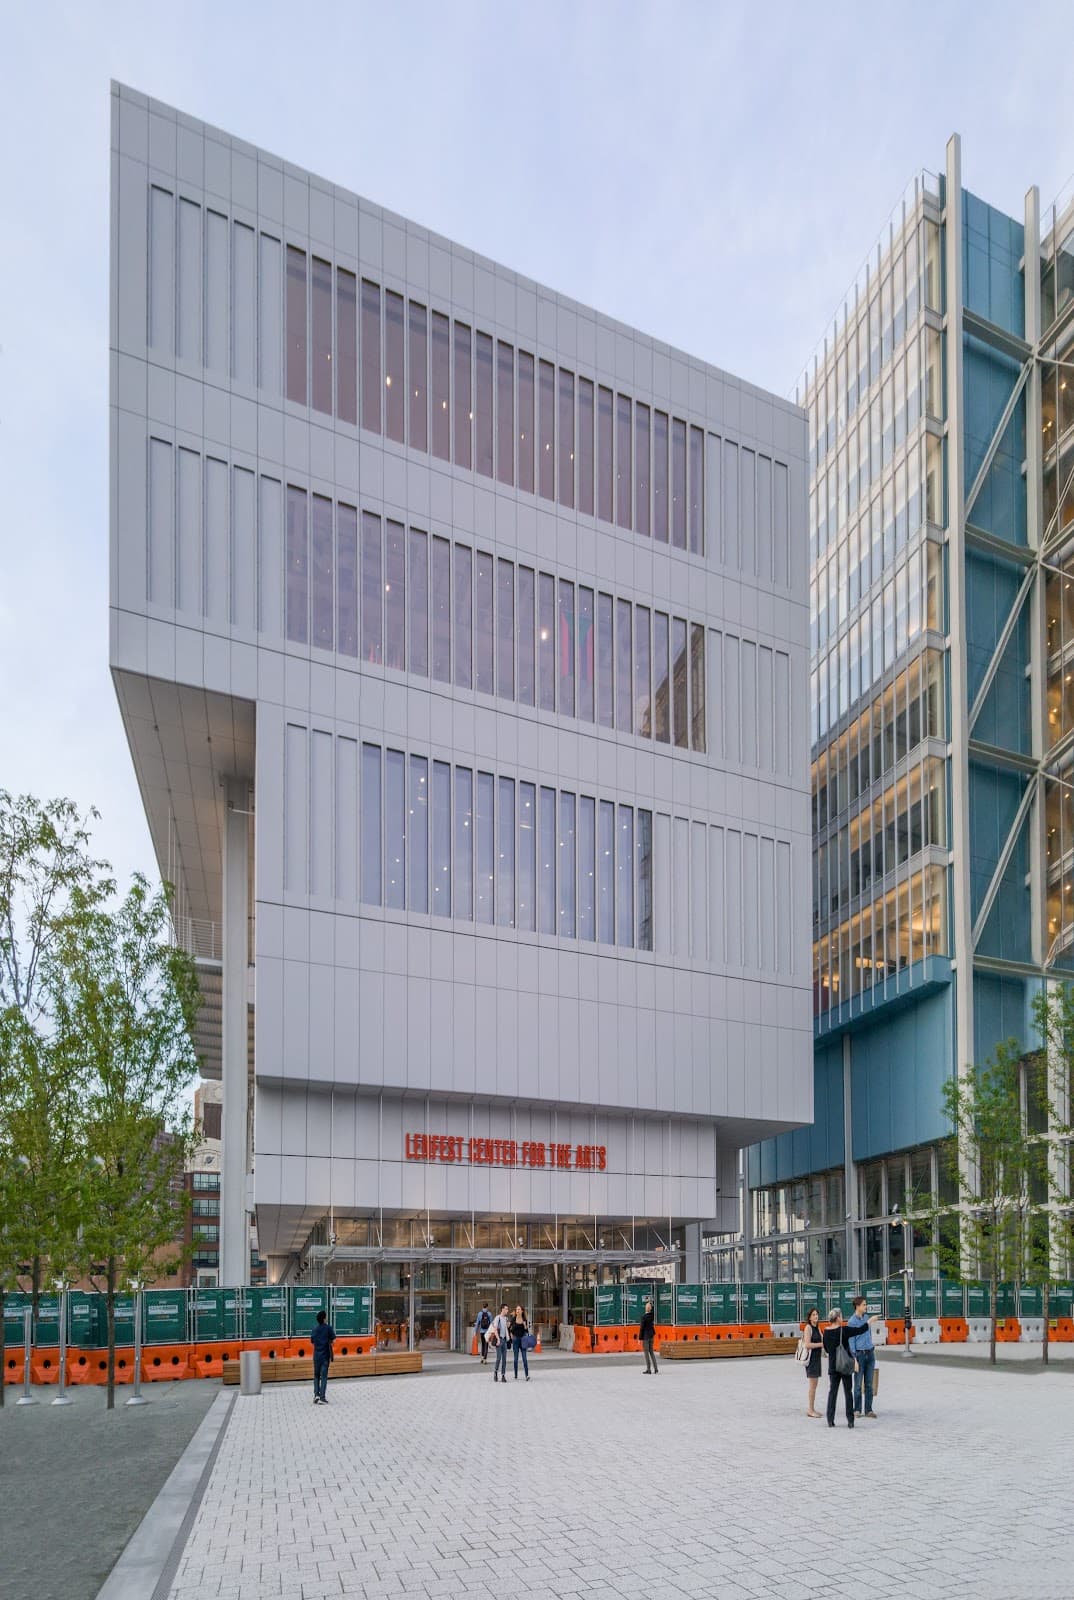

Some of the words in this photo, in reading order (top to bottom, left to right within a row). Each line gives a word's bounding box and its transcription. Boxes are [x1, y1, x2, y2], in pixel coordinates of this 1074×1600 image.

[405, 1132, 464, 1162] LENFEST
[468, 1136, 518, 1165] CENTER
[522, 1141, 546, 1167] FOR
[549, 1143, 572, 1169] THE
[575, 1144, 607, 1170] ARTS
